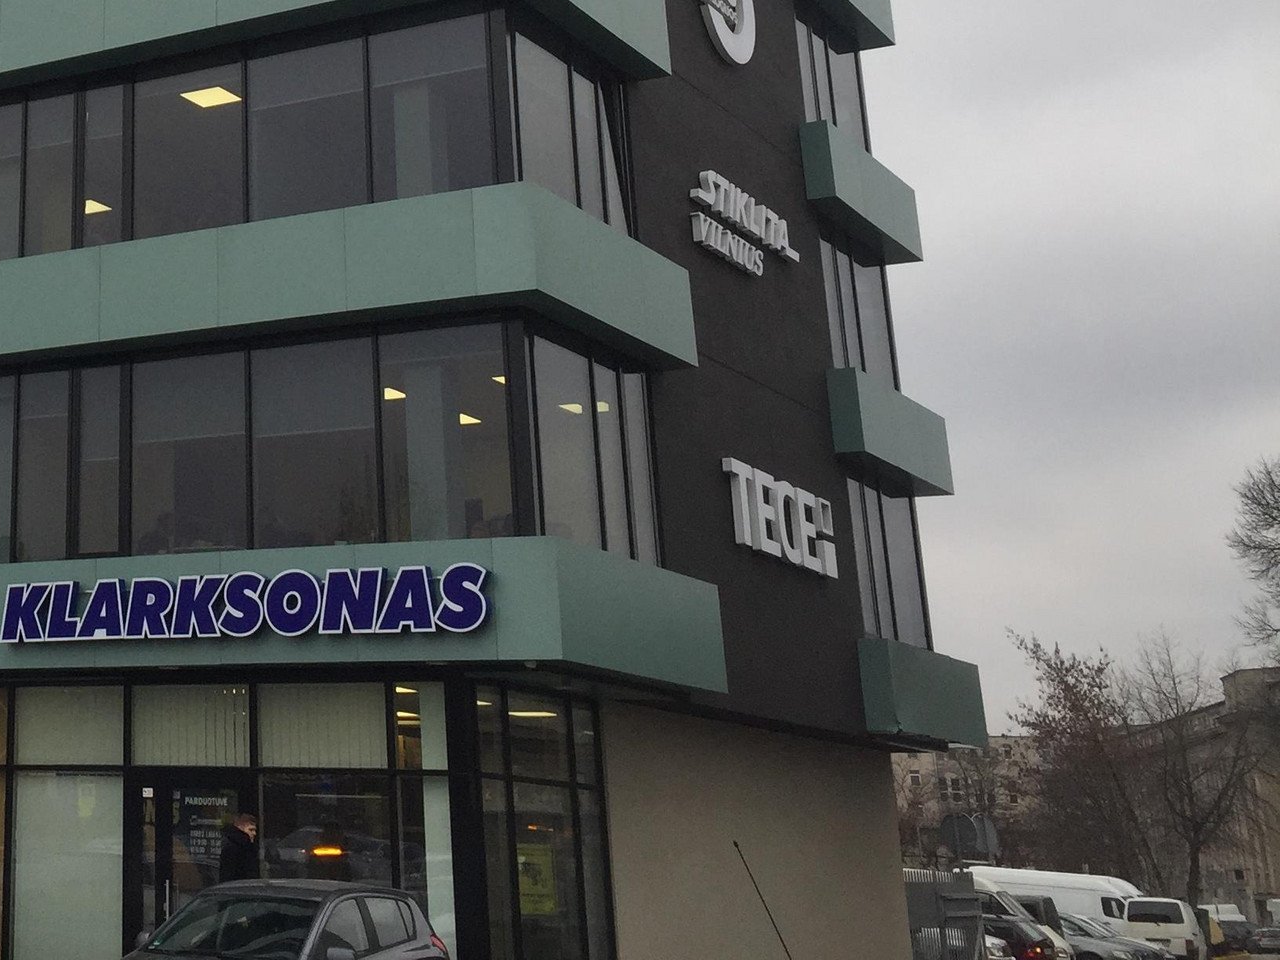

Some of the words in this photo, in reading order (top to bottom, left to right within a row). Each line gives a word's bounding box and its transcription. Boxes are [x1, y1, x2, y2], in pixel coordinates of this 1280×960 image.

[690, 169, 800, 263] STIKLITA
[690, 211, 764, 277] VILNIUS
[0, 561, 494, 643] KLARKSONAS
